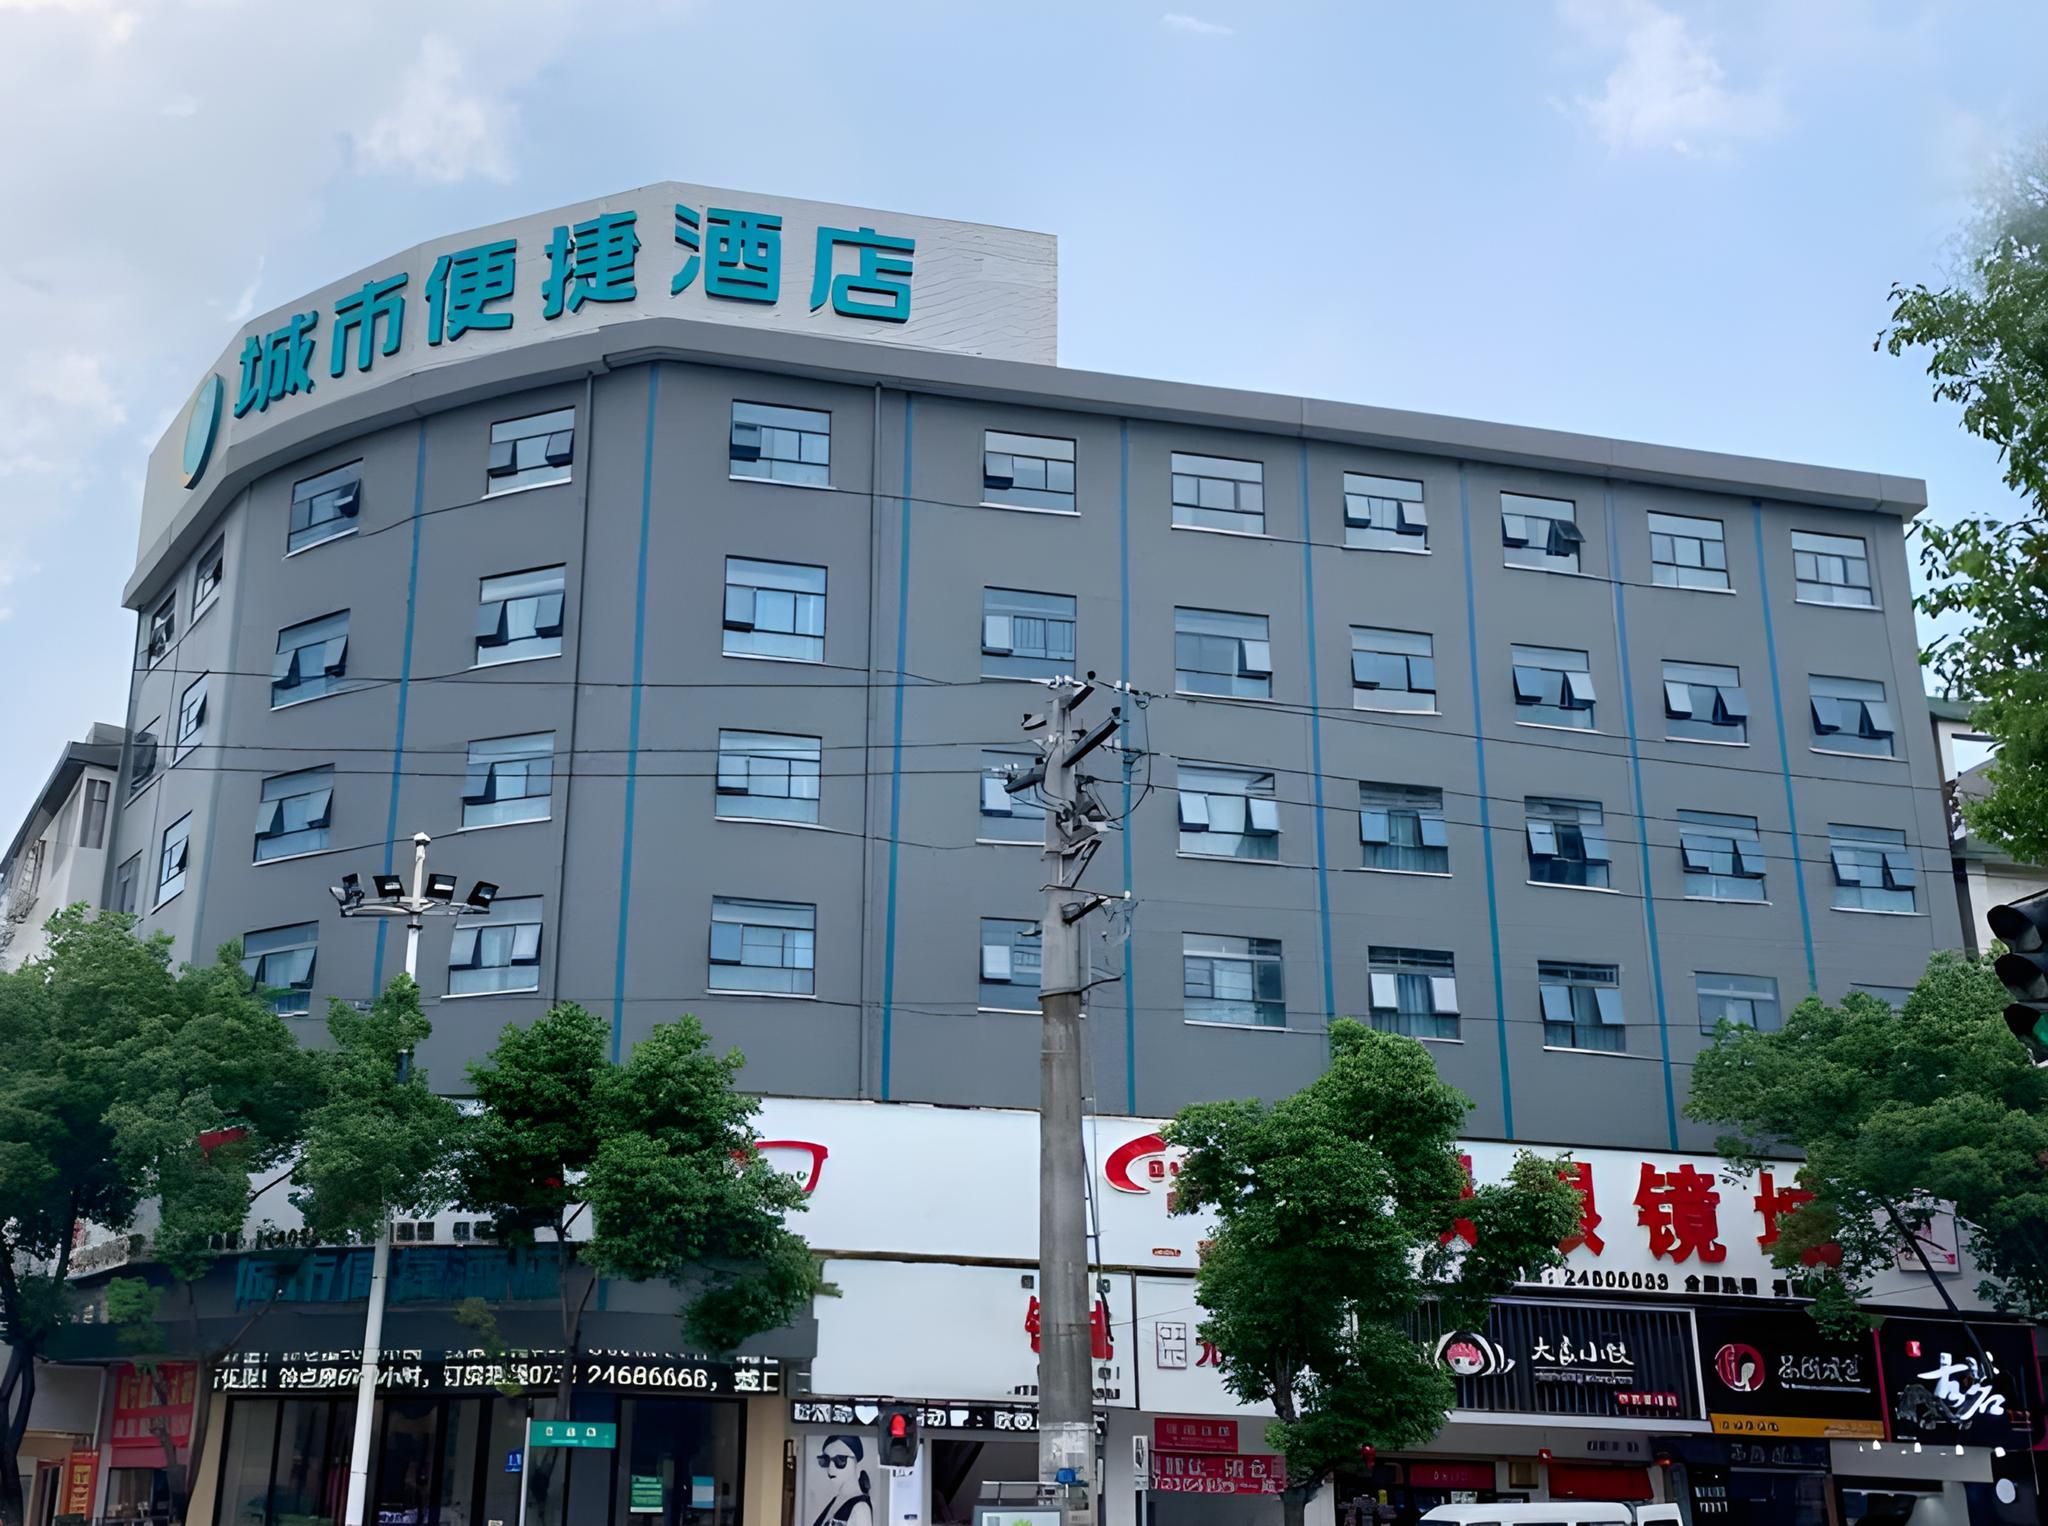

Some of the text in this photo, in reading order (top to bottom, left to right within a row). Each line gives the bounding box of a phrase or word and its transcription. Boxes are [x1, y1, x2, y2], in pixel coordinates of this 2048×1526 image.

[232, 201, 916, 419] 城市便捷酒店
